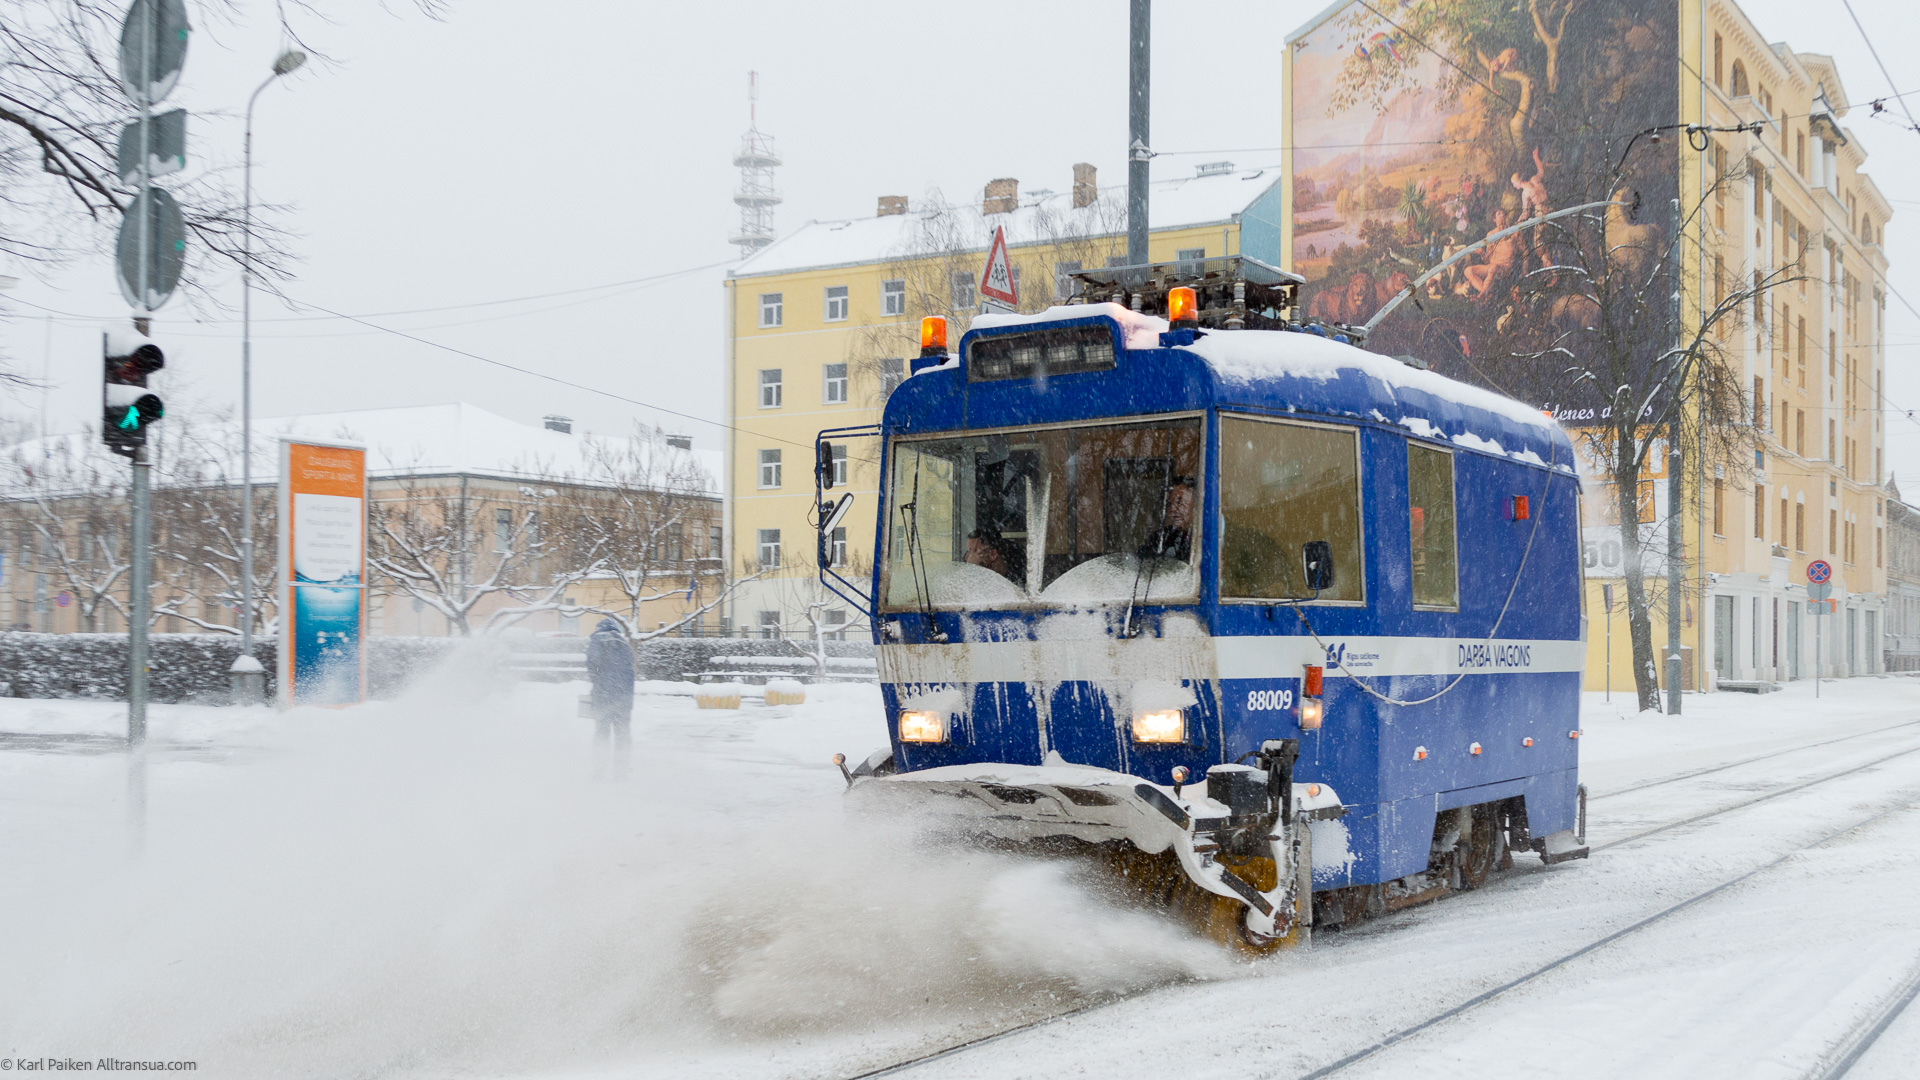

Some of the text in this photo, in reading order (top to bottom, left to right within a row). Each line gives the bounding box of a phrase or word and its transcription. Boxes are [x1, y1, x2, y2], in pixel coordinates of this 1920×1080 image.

[1541, 403, 1595, 421] denes
[1458, 644, 1530, 667] DARBA VAGONS
[1247, 689, 1293, 711] 88009
